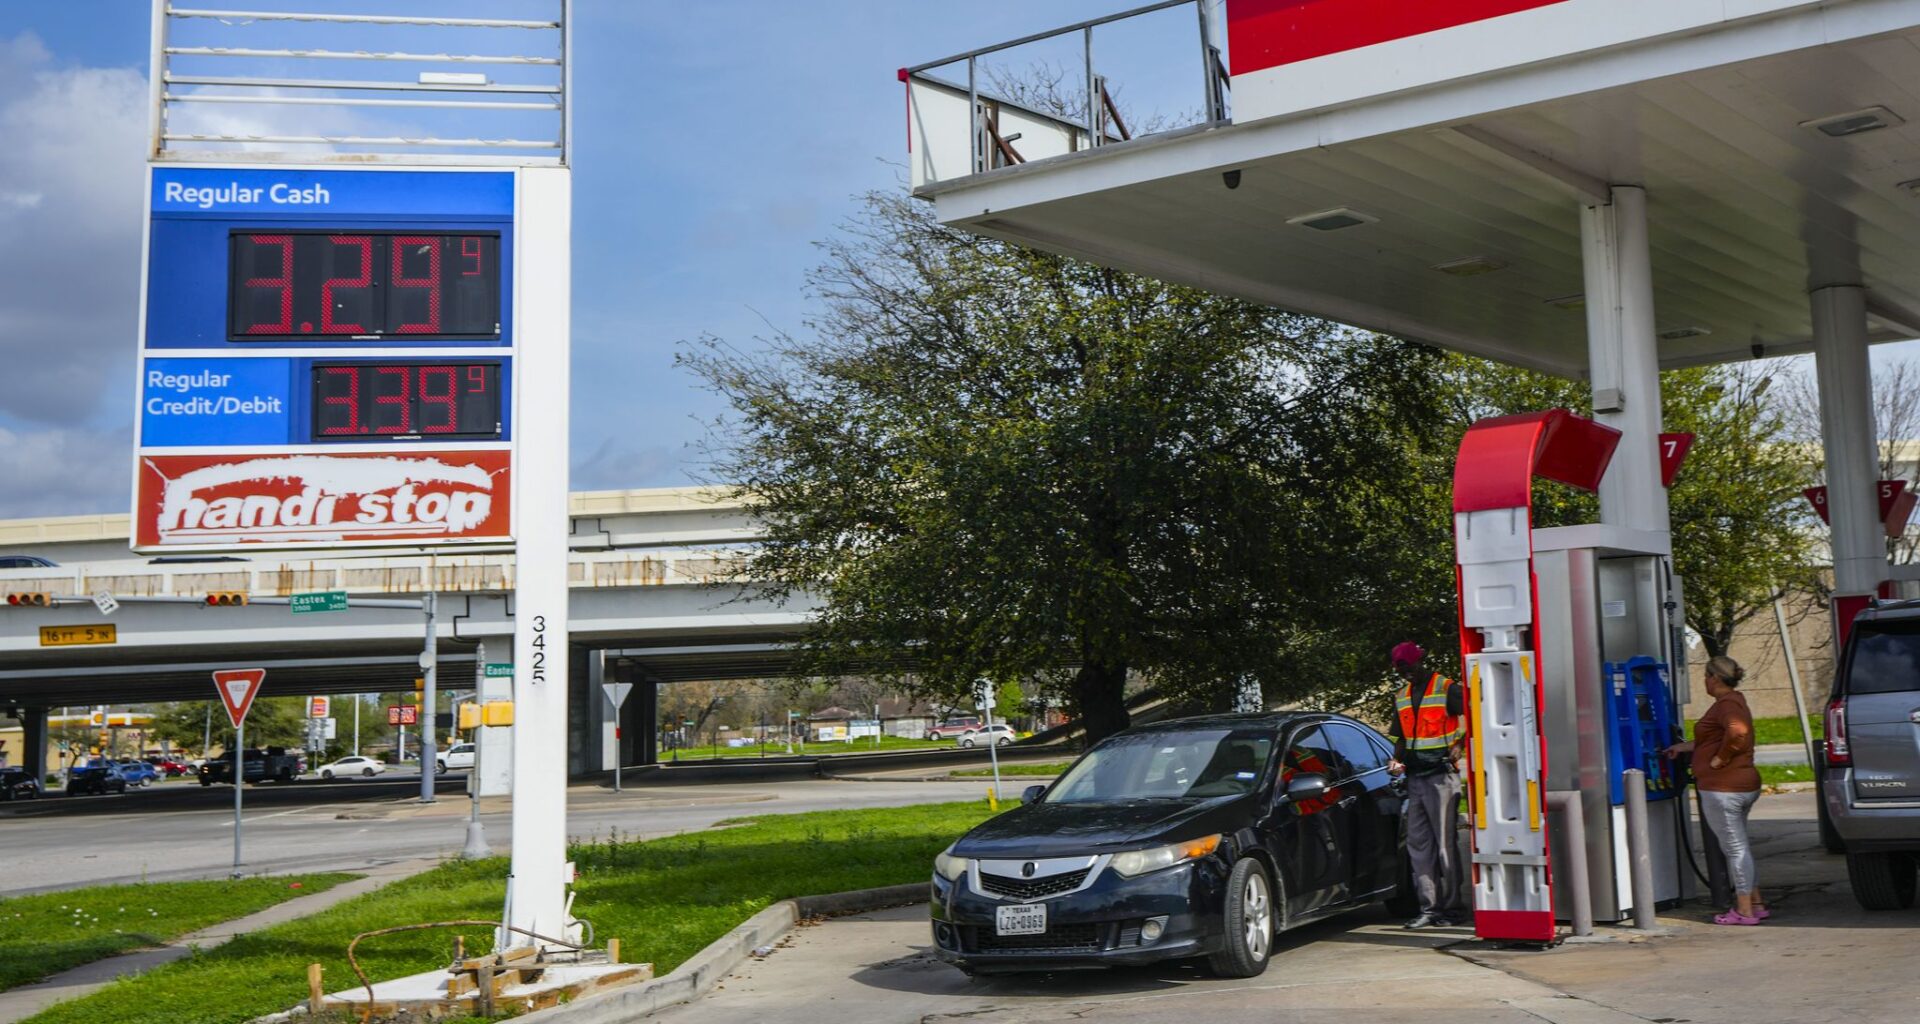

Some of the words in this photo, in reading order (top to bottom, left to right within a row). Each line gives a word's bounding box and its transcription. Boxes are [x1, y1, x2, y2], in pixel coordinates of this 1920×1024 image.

[165, 182, 264, 208] Regular
[269, 183, 330, 204] Cash
[148, 369, 232, 392] Regular
[147, 396, 282, 415] Credit/Debit
[1664, 441, 1677, 458] 7
[1816, 492, 1824, 504] 6
[1882, 484, 1892, 498] 5
[162, 482, 335, 529] handi
[355, 483, 492, 533] stop
[292, 596, 325, 605] Eastex
[46, 631, 60, 642] 16
[86, 629, 95, 641] 5
